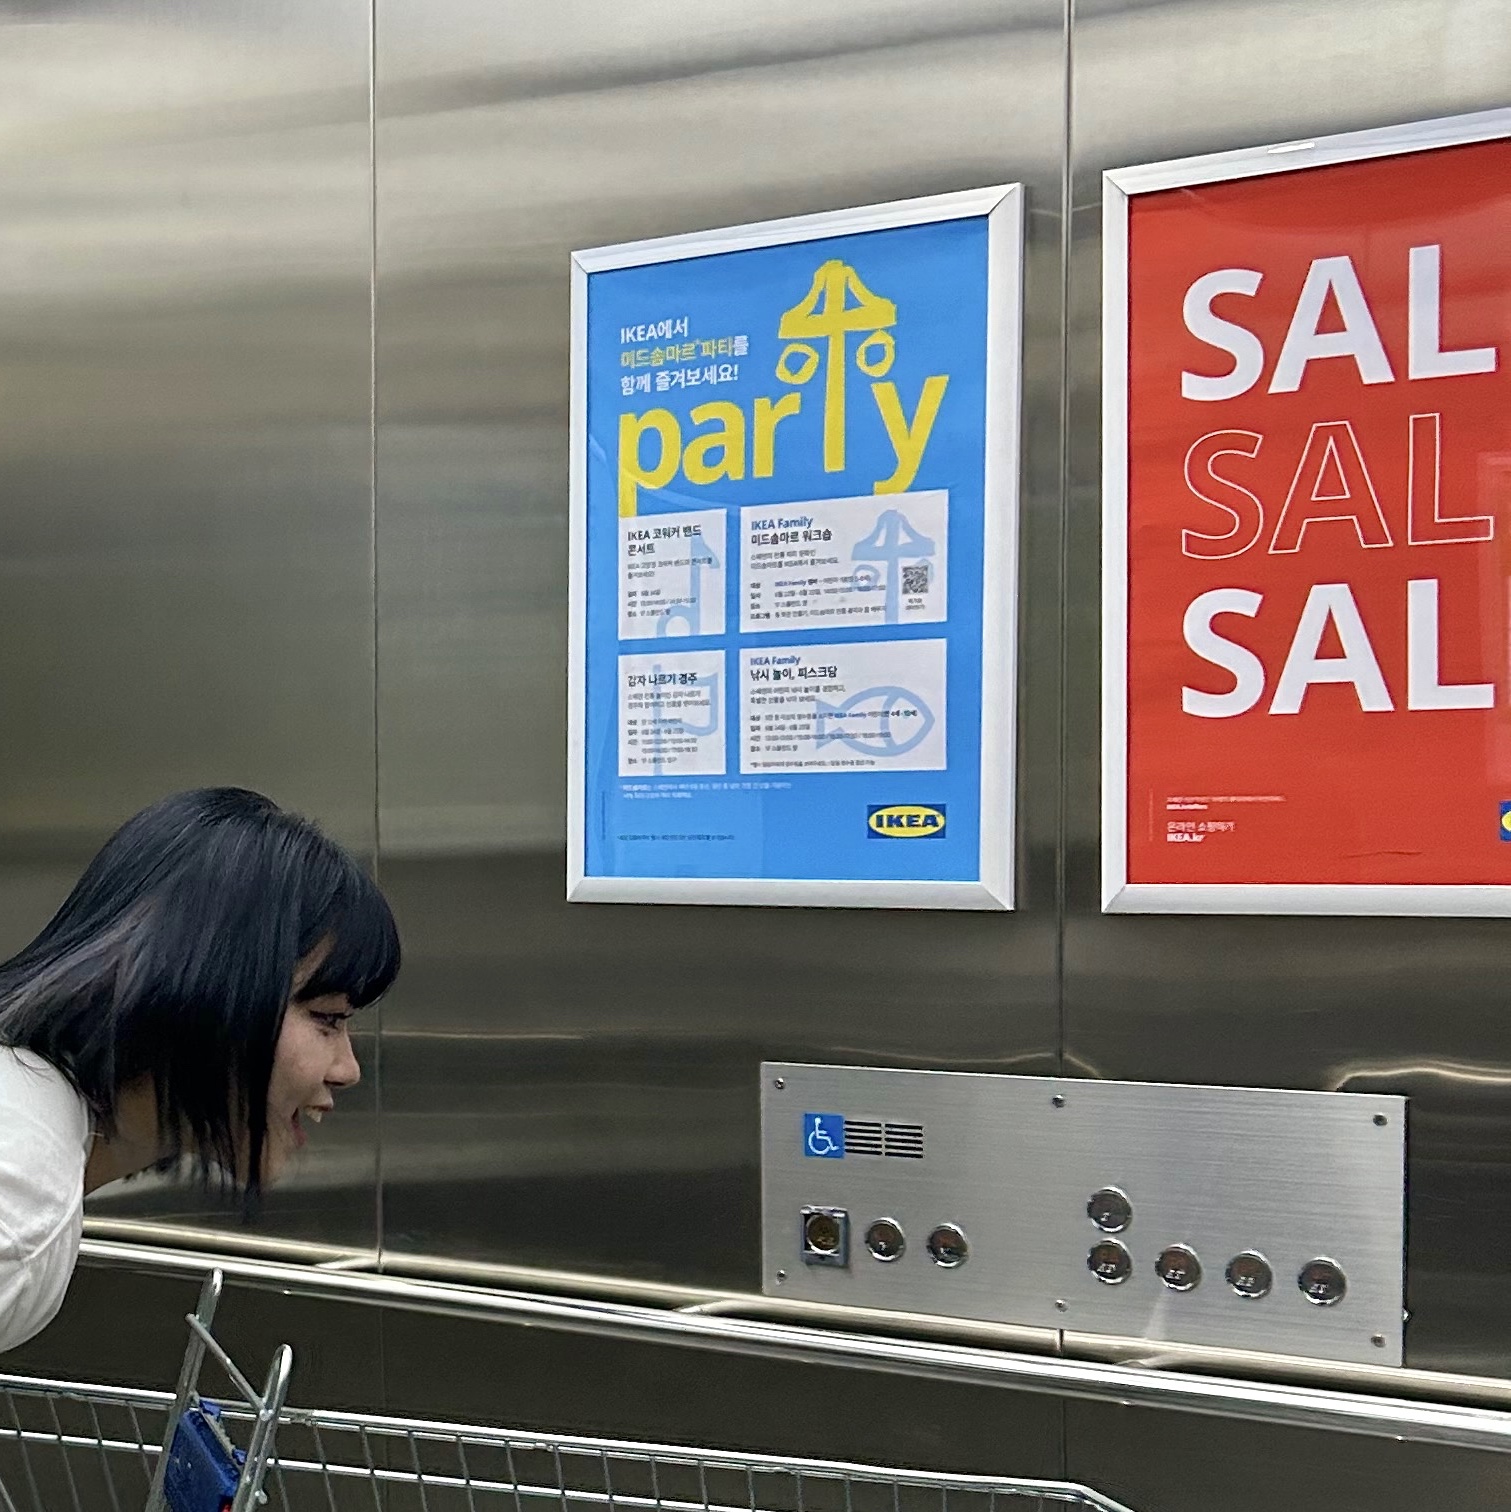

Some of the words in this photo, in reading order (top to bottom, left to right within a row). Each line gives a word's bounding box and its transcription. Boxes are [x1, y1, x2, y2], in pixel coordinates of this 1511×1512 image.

[620, 316, 689, 345] IKEA에서
[620, 372, 651, 396] 함께
[655, 364, 739, 392] 즐겨보세요!
[751, 517, 776, 531] IKEA
[778, 515, 814, 530] Family
[627, 530, 651, 541] IKEA
[682, 524, 702, 537] 밴드
[772, 655, 801, 666] Family
[627, 674, 647, 687] 감자
[648, 673, 677, 686] 나르기
[678, 672, 698, 685] 경주
[875, 813, 940, 828] IKEA
